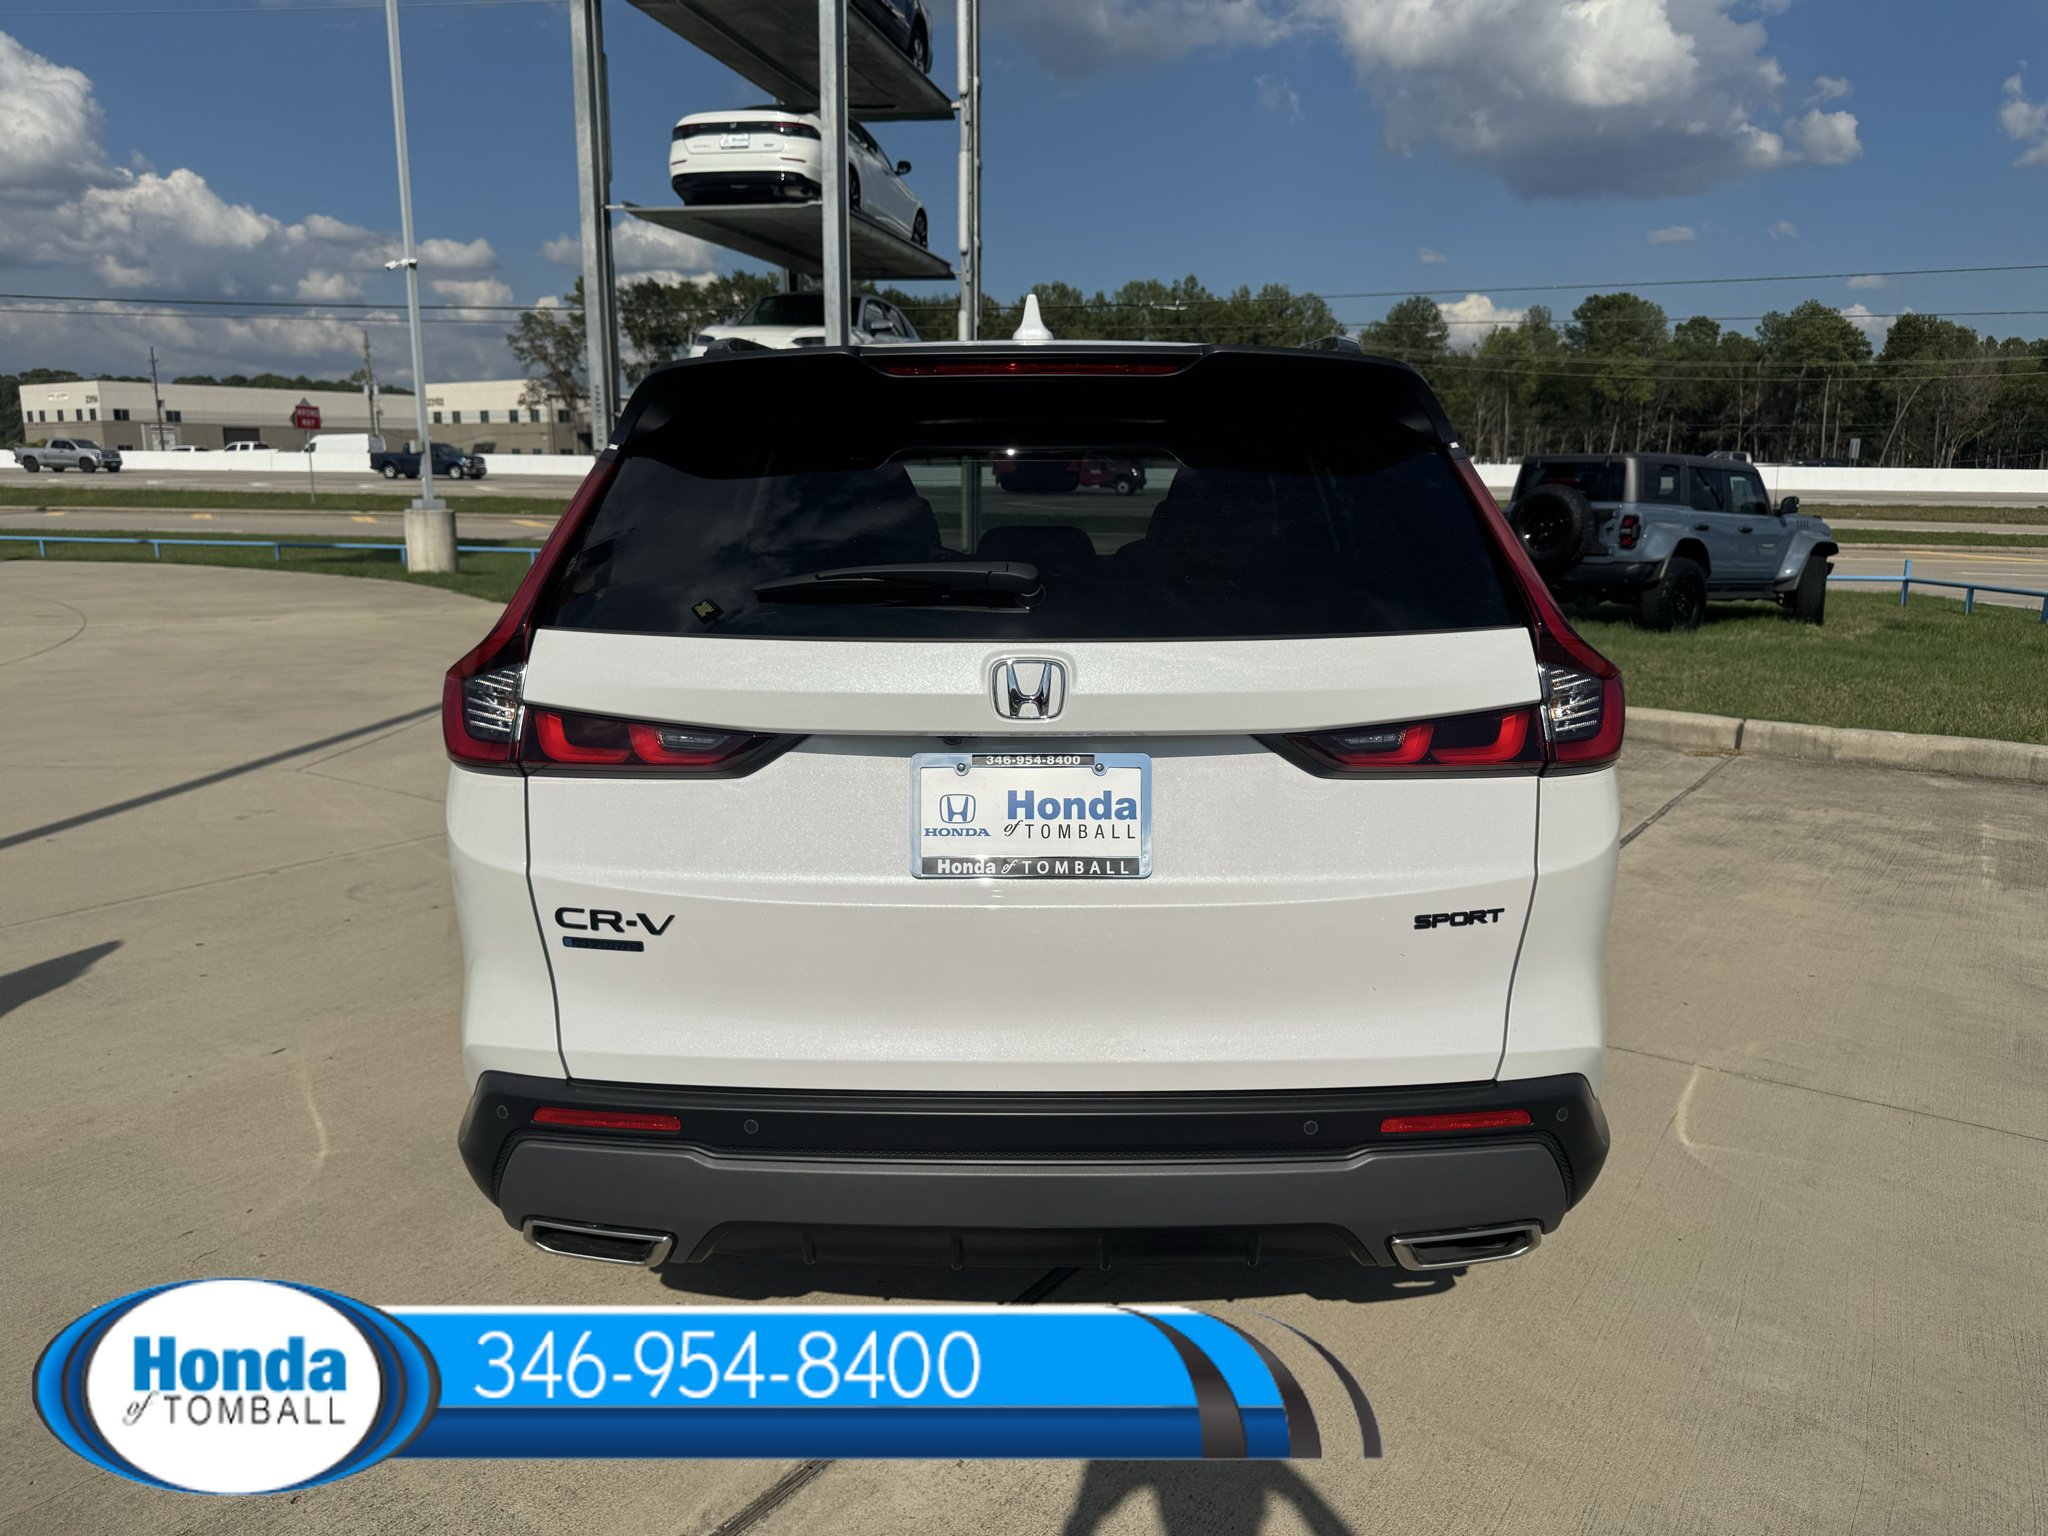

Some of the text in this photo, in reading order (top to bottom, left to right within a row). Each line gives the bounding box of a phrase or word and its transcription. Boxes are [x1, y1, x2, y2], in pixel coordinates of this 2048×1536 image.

[986, 755, 1081, 765] 346-954-8400
[1007, 790, 1138, 821] Honda
[923, 828, 991, 837] HONDA
[1003, 820, 1136, 839] of TOMBALL
[937, 859, 1129, 875] Honda of TOMBALL
[555, 907, 676, 936] CR-V
[1413, 907, 1505, 930] SPORT
